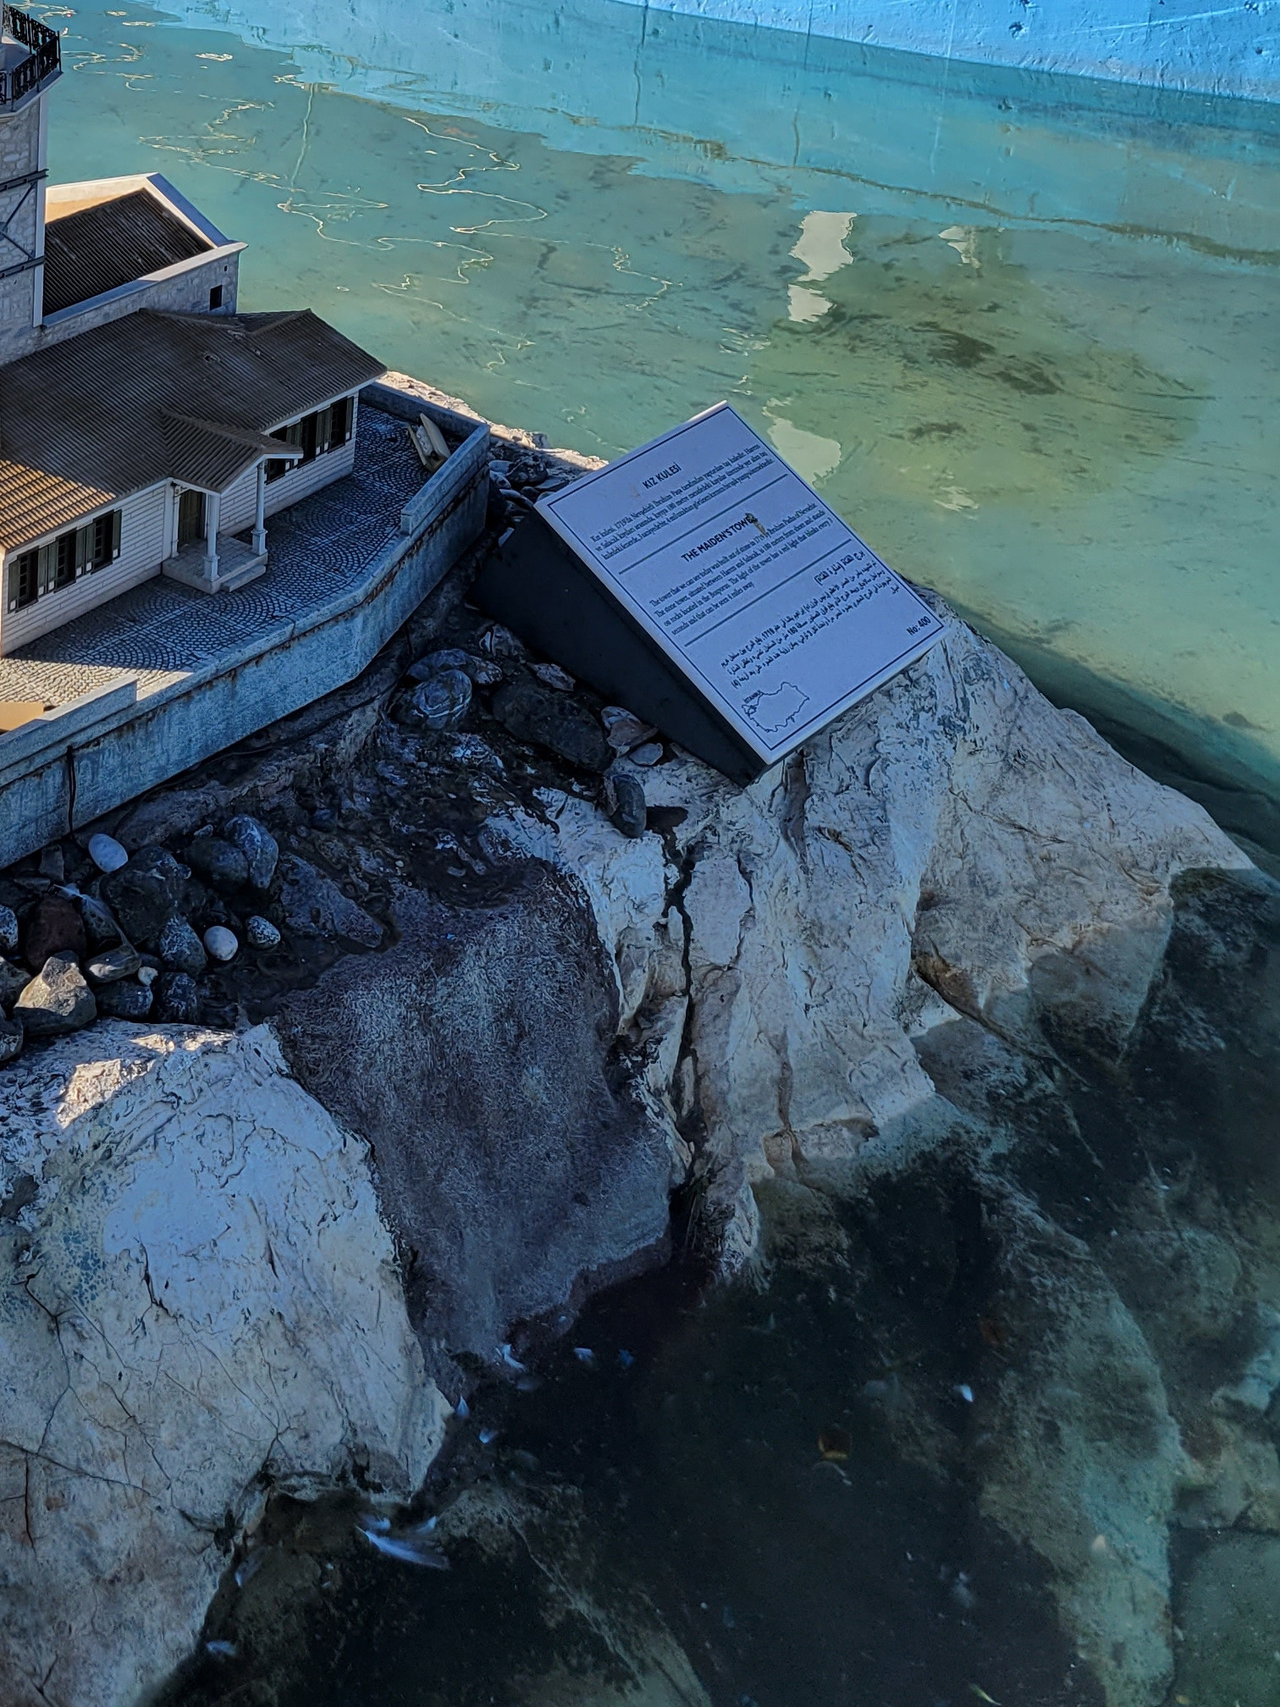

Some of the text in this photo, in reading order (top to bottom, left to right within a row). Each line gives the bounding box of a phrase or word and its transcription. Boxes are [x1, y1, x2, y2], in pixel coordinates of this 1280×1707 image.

[642, 462, 682, 489] KIZ KULESİ
[681, 548, 700, 562] THE
[729, 514, 758, 533] TOWE
[654, 610, 666, 618] The
[906, 616, 931, 636] No: 400
